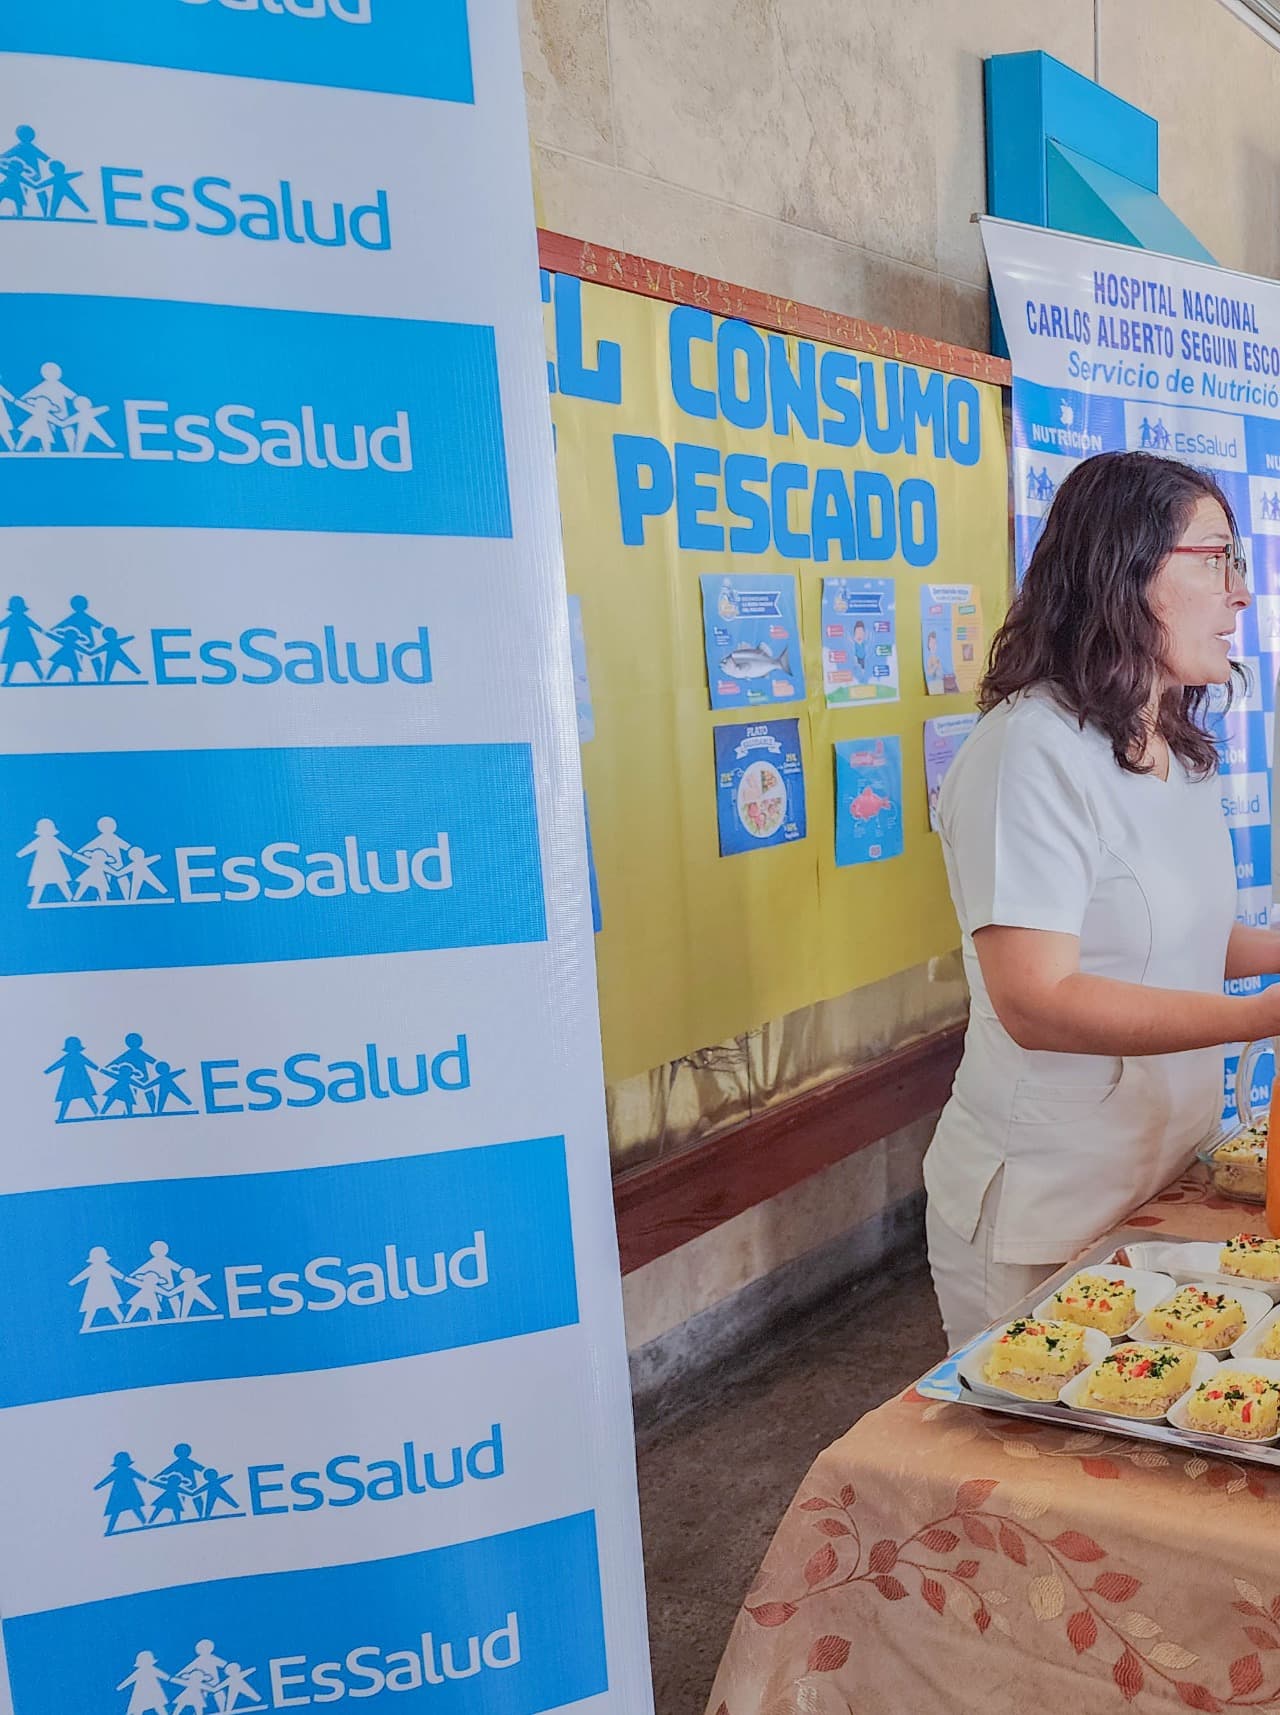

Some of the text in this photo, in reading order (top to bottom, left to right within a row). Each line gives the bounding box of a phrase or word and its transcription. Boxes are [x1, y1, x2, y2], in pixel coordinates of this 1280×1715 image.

[100, 166, 391, 250] EsSalud
[1026, 300, 1091, 345] CARLOS
[1098, 315, 1174, 359] ALBERTO
[1181, 329, 1238, 369] SEGUIN
[1093, 271, 1259, 334] HOSPITAL NACIONAL
[540, 268, 621, 404] L
[669, 305, 981, 467] CONSUMO
[1068, 351, 1160, 390] Servicio
[1166, 367, 1195, 395] de
[123, 399, 413, 472] EsSalud
[1032, 423, 1102, 450] NUTRICIÓN
[1175, 435, 1237, 459] EsSalud
[613, 433, 938, 567] PESCADO
[150, 625, 433, 686] EsSalud
[175, 832, 453, 904] EsSalud
[200, 1033, 471, 1115] EsSalud
[224, 1230, 488, 1320] EsSalud
[247, 1423, 505, 1518] EsSalud
[268, 1611, 521, 1709] EsSalud
